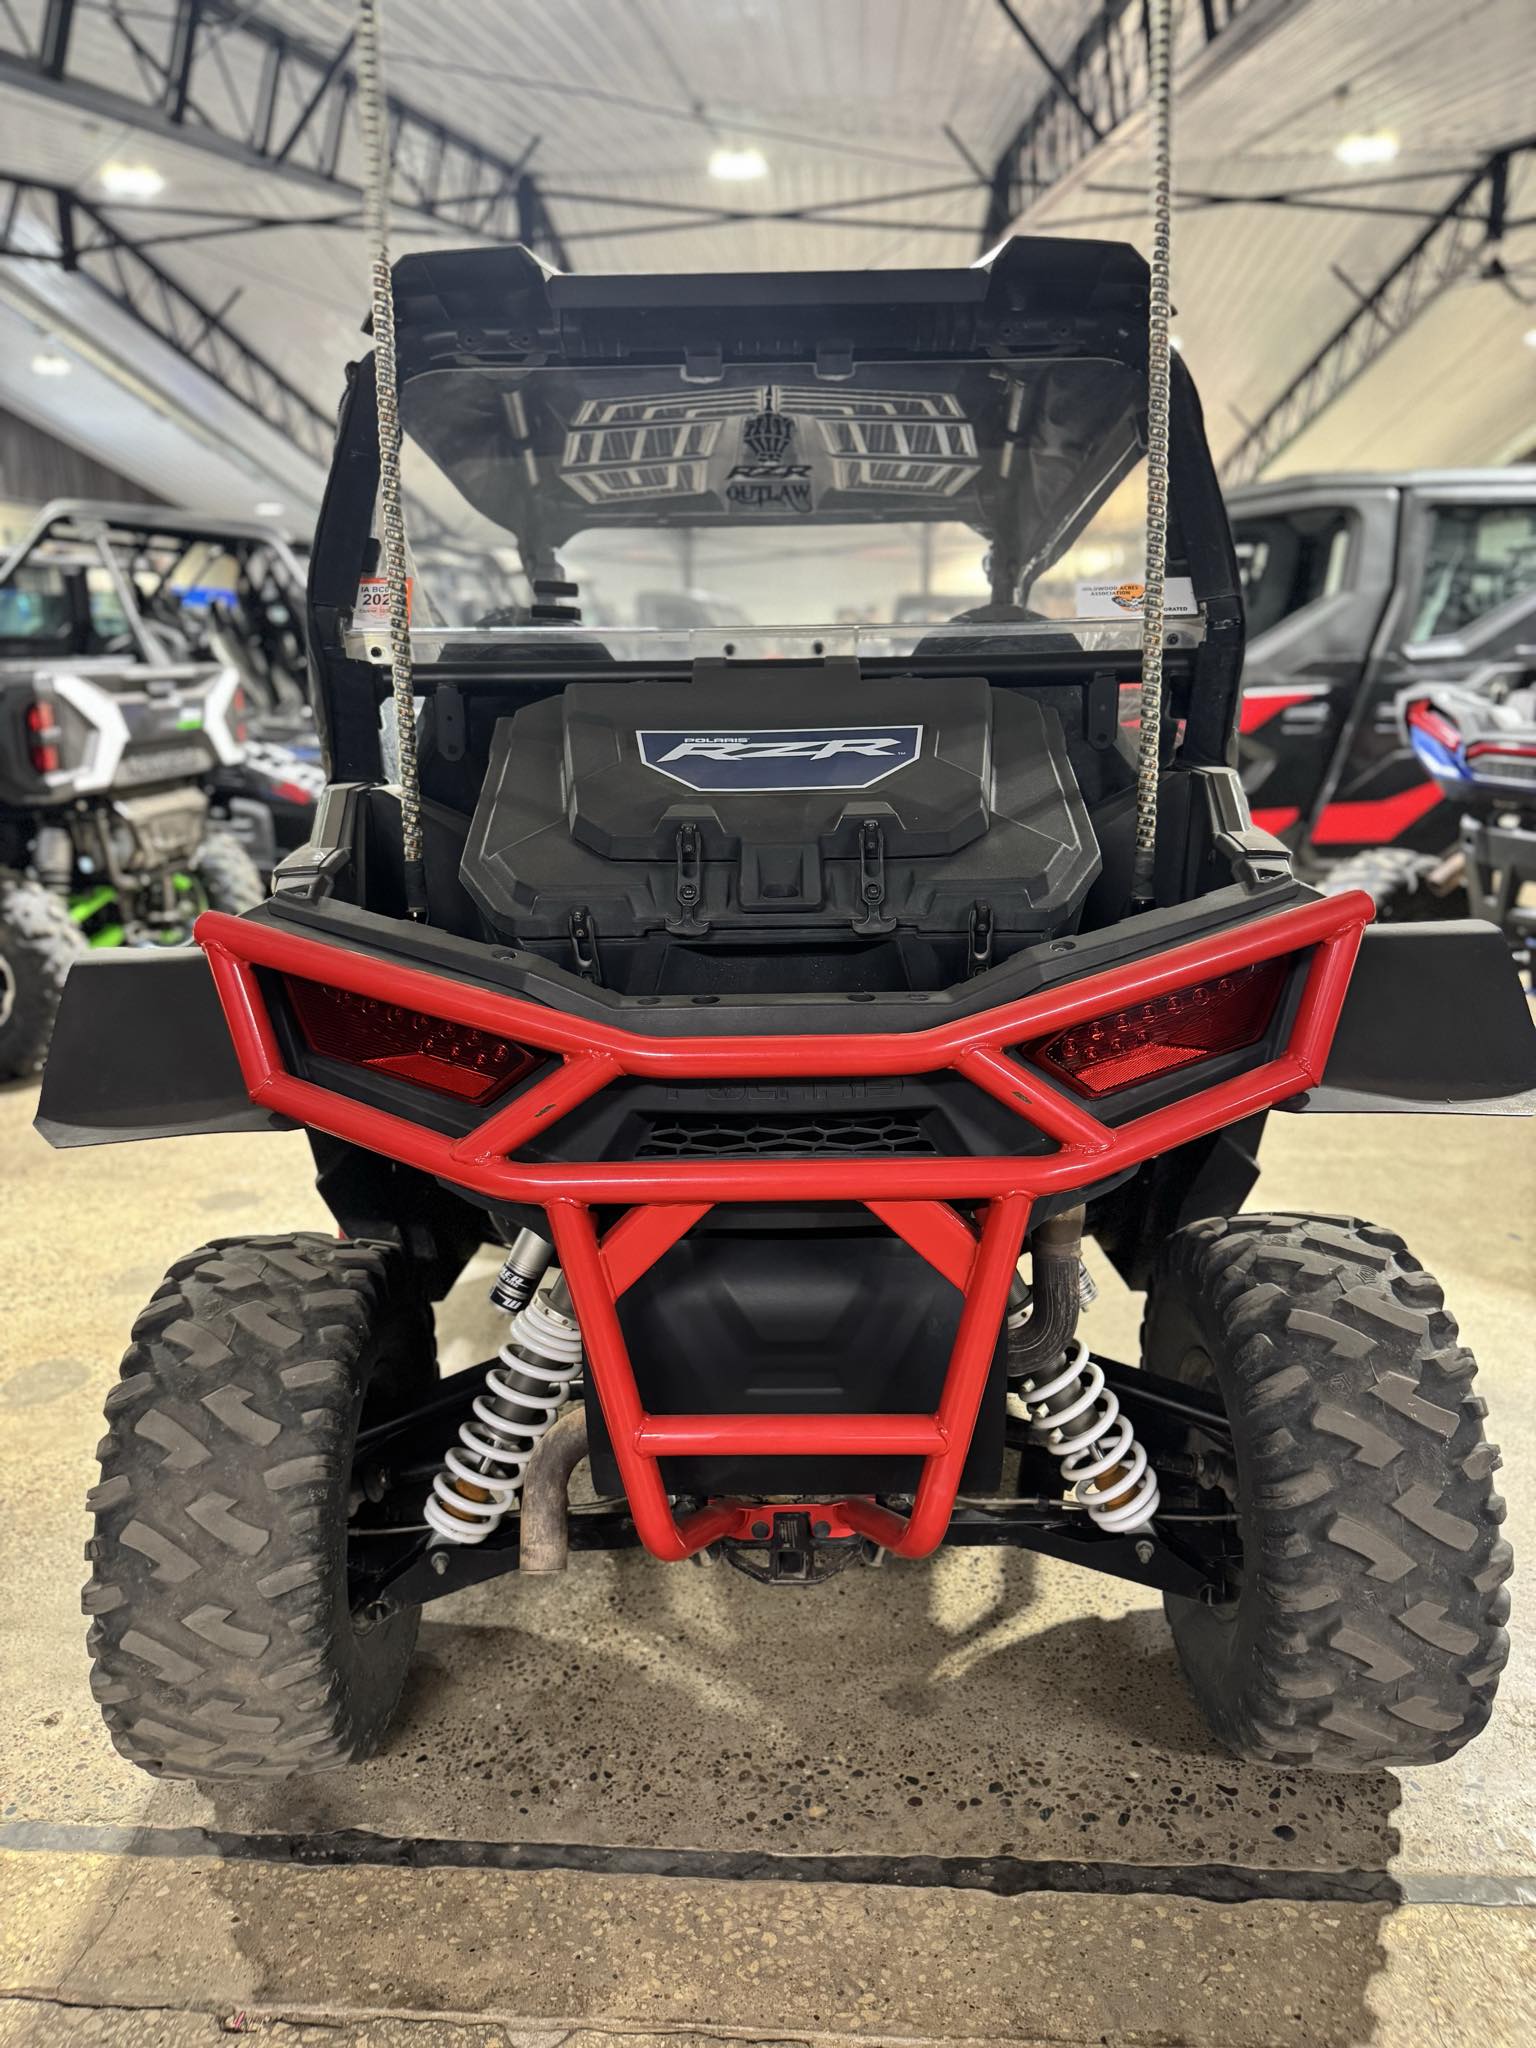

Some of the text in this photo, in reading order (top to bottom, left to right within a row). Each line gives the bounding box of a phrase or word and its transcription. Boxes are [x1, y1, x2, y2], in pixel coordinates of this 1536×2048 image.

[727, 465, 812, 480] RZR
[726, 484, 812, 513] OUTLAW
[656, 738, 902, 763] RZR
